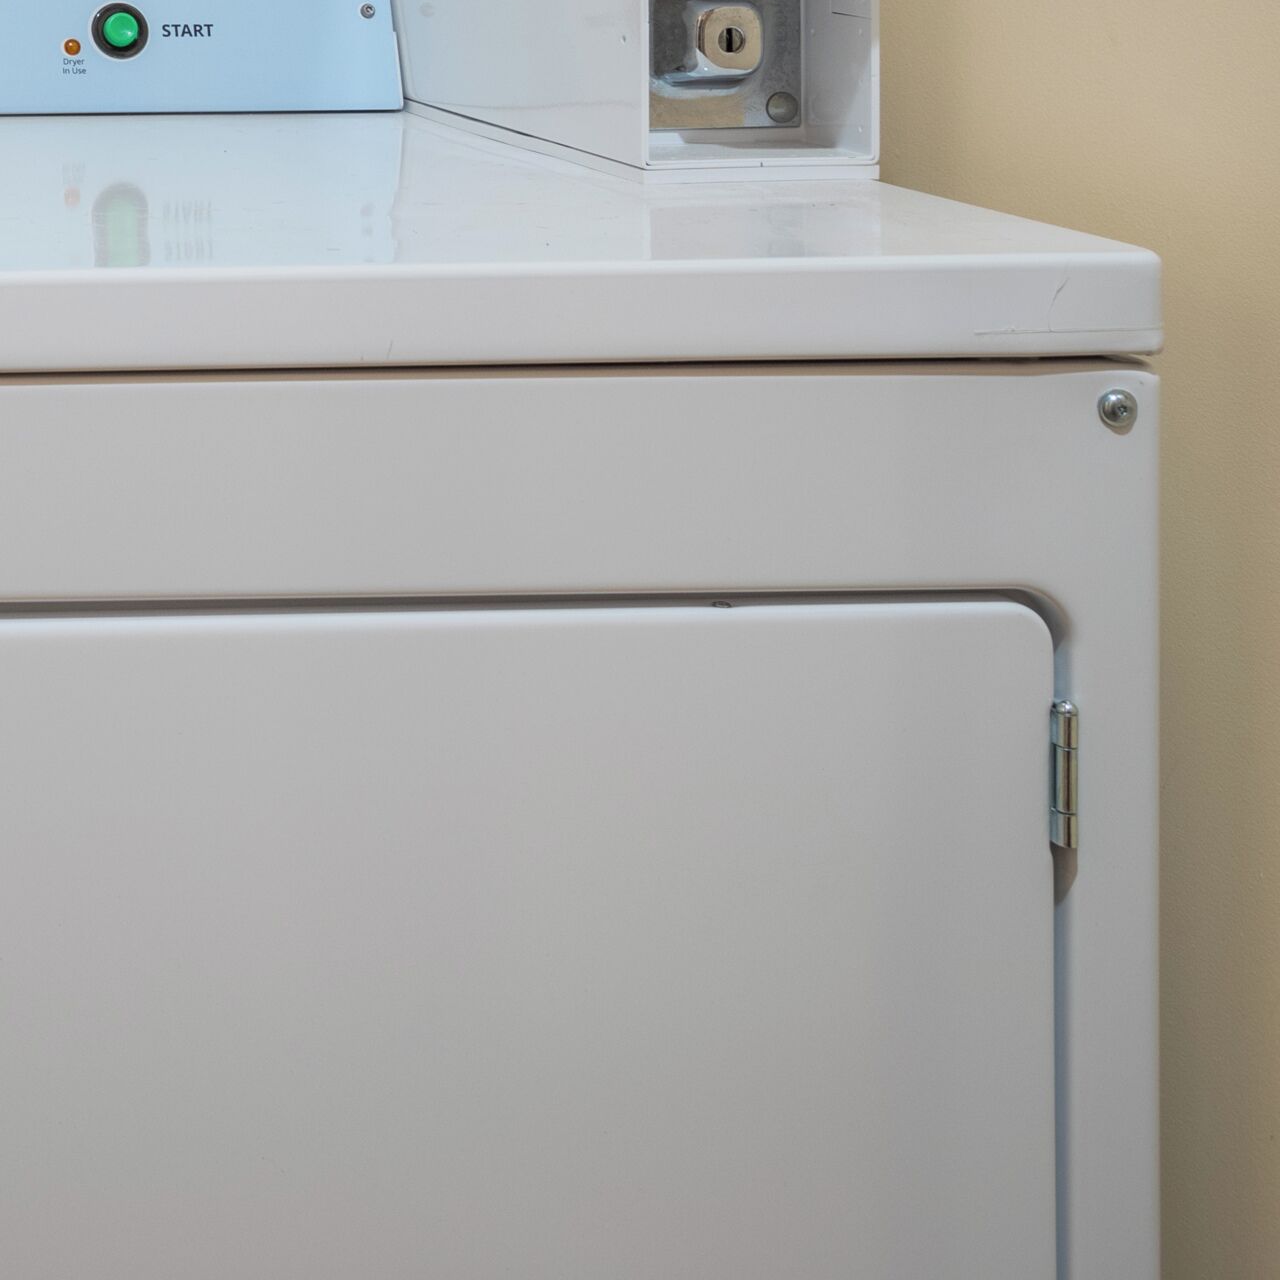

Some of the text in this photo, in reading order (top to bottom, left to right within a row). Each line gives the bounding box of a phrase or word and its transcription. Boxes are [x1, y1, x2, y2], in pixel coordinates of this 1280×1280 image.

[162, 24, 213, 37] START
[63, 58, 85, 67] Dryer
[72, 67, 87, 75] Use
